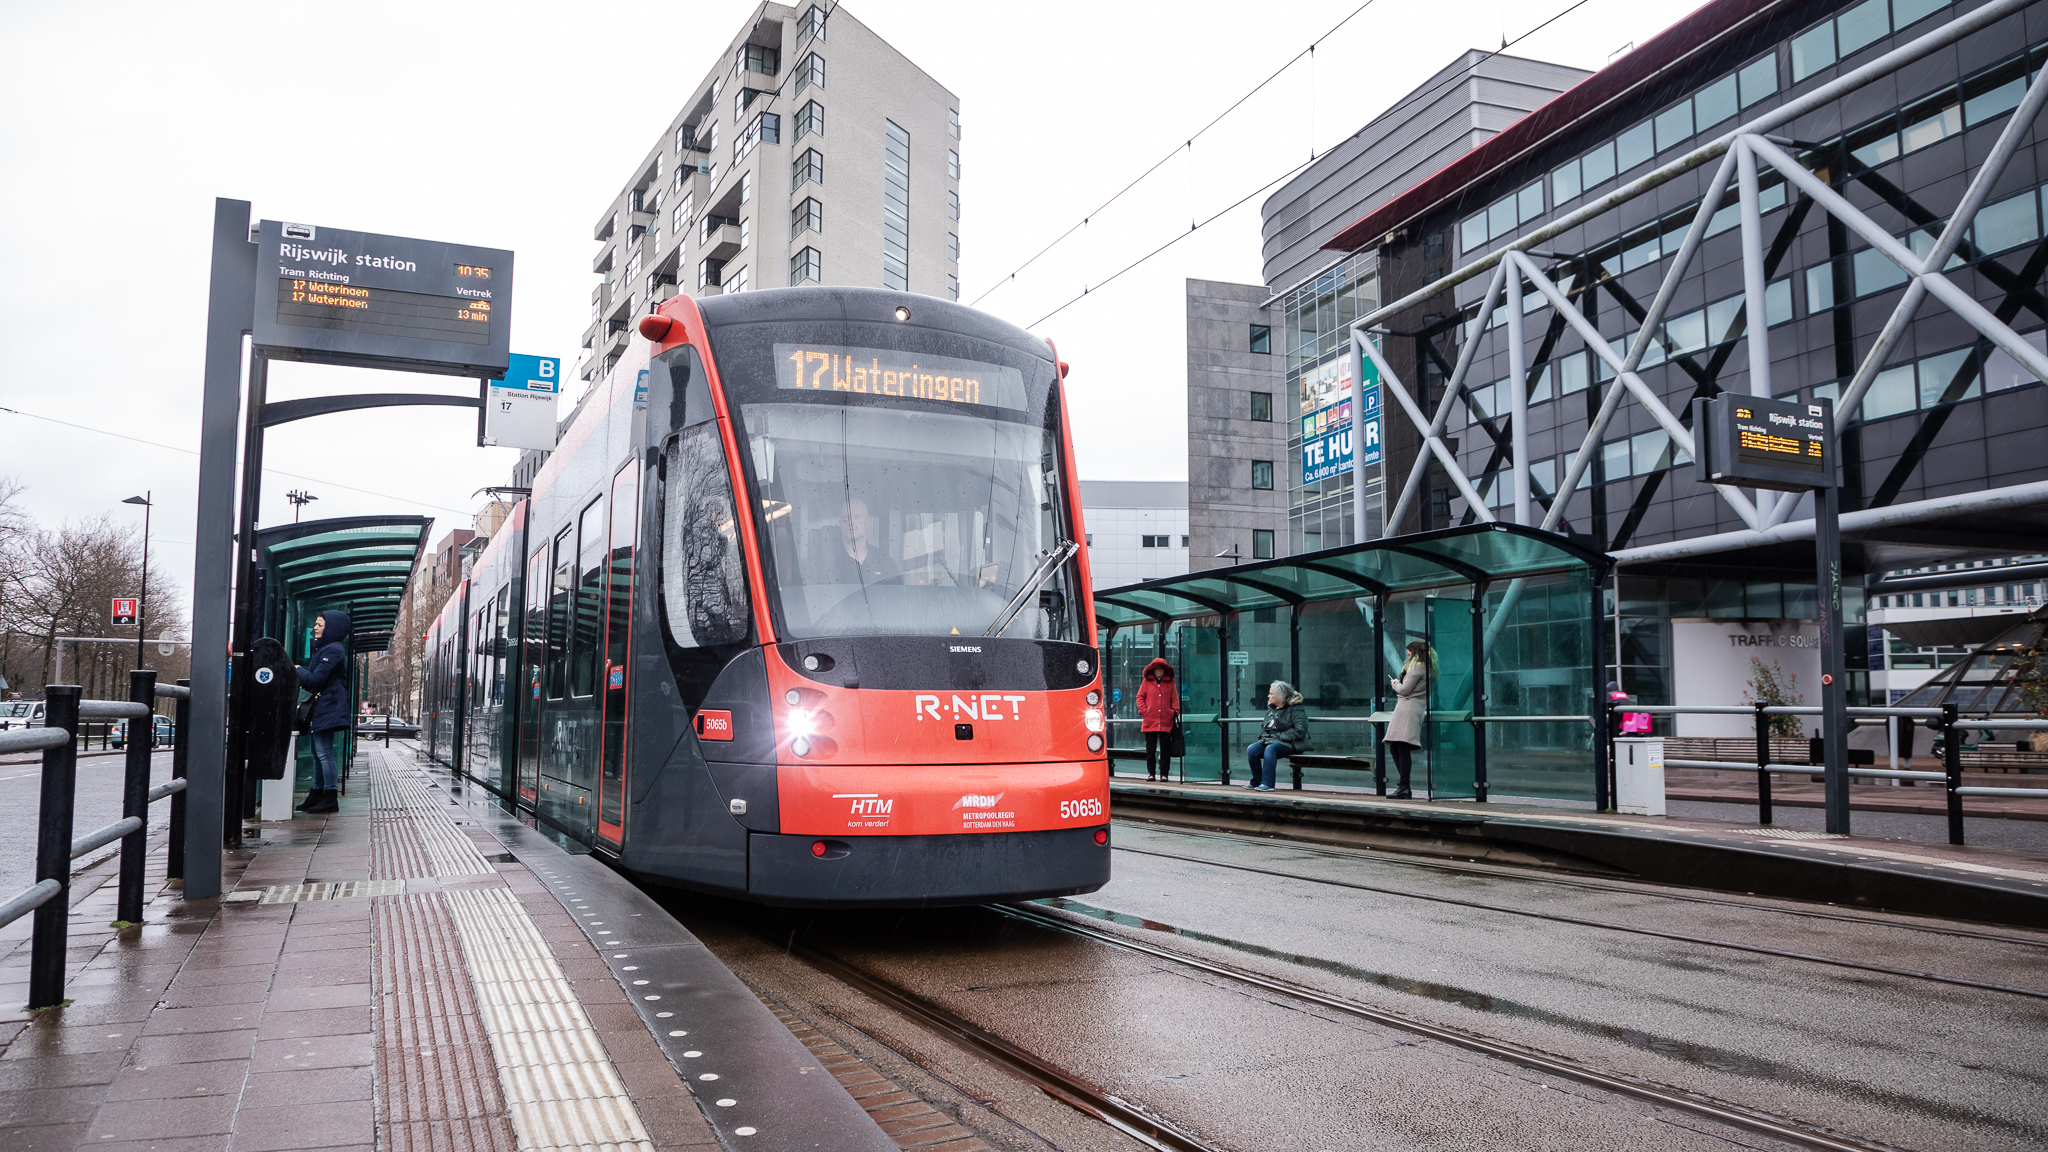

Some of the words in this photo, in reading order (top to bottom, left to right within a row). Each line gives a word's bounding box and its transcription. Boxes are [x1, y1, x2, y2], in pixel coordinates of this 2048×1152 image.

[279, 243, 348, 266] Rijswijk
[355, 254, 417, 272] station
[279, 266, 305, 277] Tram
[309, 269, 350, 284] Richting
[293, 279, 306, 290] 17
[292, 291, 306, 302] 17
[456, 286, 492, 299] Vertrek
[458, 309, 470, 320] 13
[471, 311, 488, 322] min
[539, 359, 555, 378] B
[789, 350, 829, 389] 17
[833, 354, 980, 404] Wateringen
[507, 391, 529, 399] Station
[530, 393, 552, 402] Rijswijk
[501, 402, 513, 411] 17
[1769, 412, 1796, 427] Rijswijk
[1798, 418, 1823, 429] station
[1304, 440, 1325, 467] TE
[1329, 421, 1379, 460] HUR
[1728, 634, 1786, 647] TRAFFIC
[949, 645, 982, 653] SIEMENS
[706, 718, 728, 731] 5065b
[850, 799, 893, 814] HTM
[962, 795, 995, 808] MRDH
[1060, 798, 1102, 819] 5065b
[963, 811, 1015, 820] METROPOOLREGIO
[847, 819, 863, 828] kom
[864, 819, 889, 828] verder!
[963, 821, 991, 829] ROTTERDAM
[992, 821, 1002, 829] DEN
[1003, 820, 1015, 829] HAAG
